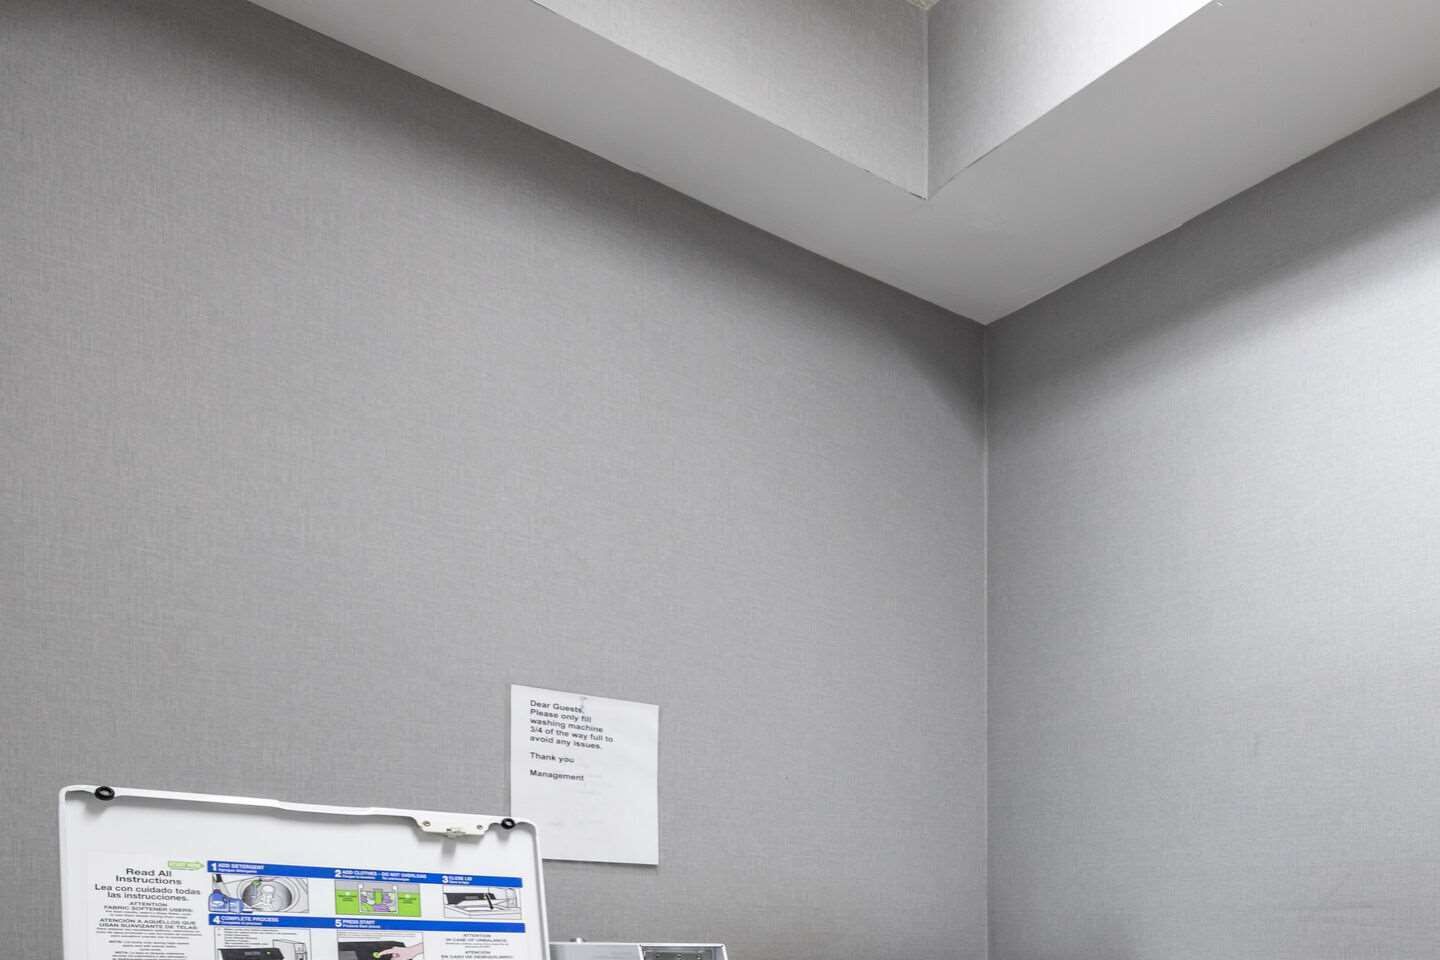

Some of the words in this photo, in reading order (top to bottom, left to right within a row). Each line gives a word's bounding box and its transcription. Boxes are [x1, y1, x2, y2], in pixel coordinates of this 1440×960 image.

[530, 700, 550, 709] Dear
[530, 709, 558, 719] Please
[561, 713, 578, 722] only
[581, 713, 592, 723] fill
[530, 719, 566, 729] washing
[568, 722, 603, 732] machine
[556, 729, 569, 737] the
[571, 732, 588, 740] way
[590, 732, 603, 741] full
[530, 736, 554, 744] avoid
[556, 739, 571, 747] any
[530, 752, 556, 761] Thank
[530, 769, 584, 781] Management
[211, 863, 216, 871] 1
[126, 868, 155, 876] Read
[334, 870, 341, 878] 2
[116, 875, 182, 885] Instructions
[213, 916, 220, 924] 4
